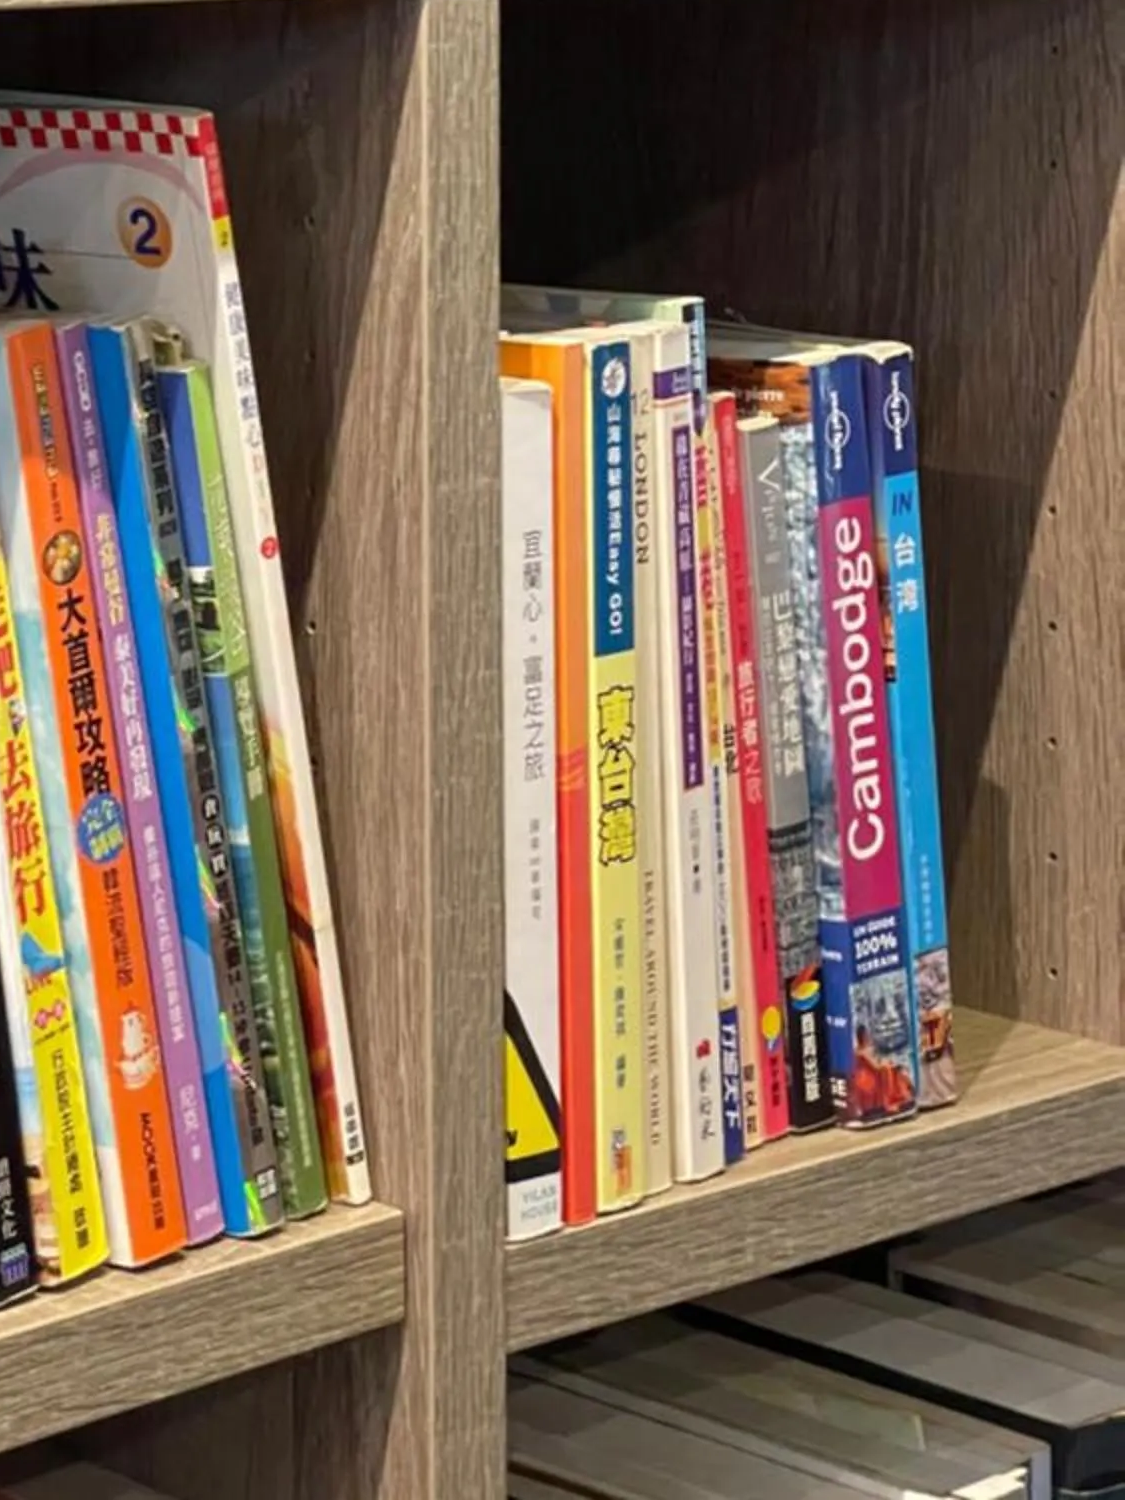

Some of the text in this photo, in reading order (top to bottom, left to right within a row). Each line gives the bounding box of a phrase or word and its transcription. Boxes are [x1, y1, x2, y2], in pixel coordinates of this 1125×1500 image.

[129, 206, 163, 257] 2
[633, 430, 652, 567] LONDON
[891, 491, 913, 517] IN
[56, 587, 111, 794] 大首爾攻略
[832, 516, 886, 861] Cambodge
[854, 937, 898, 960] 100%
